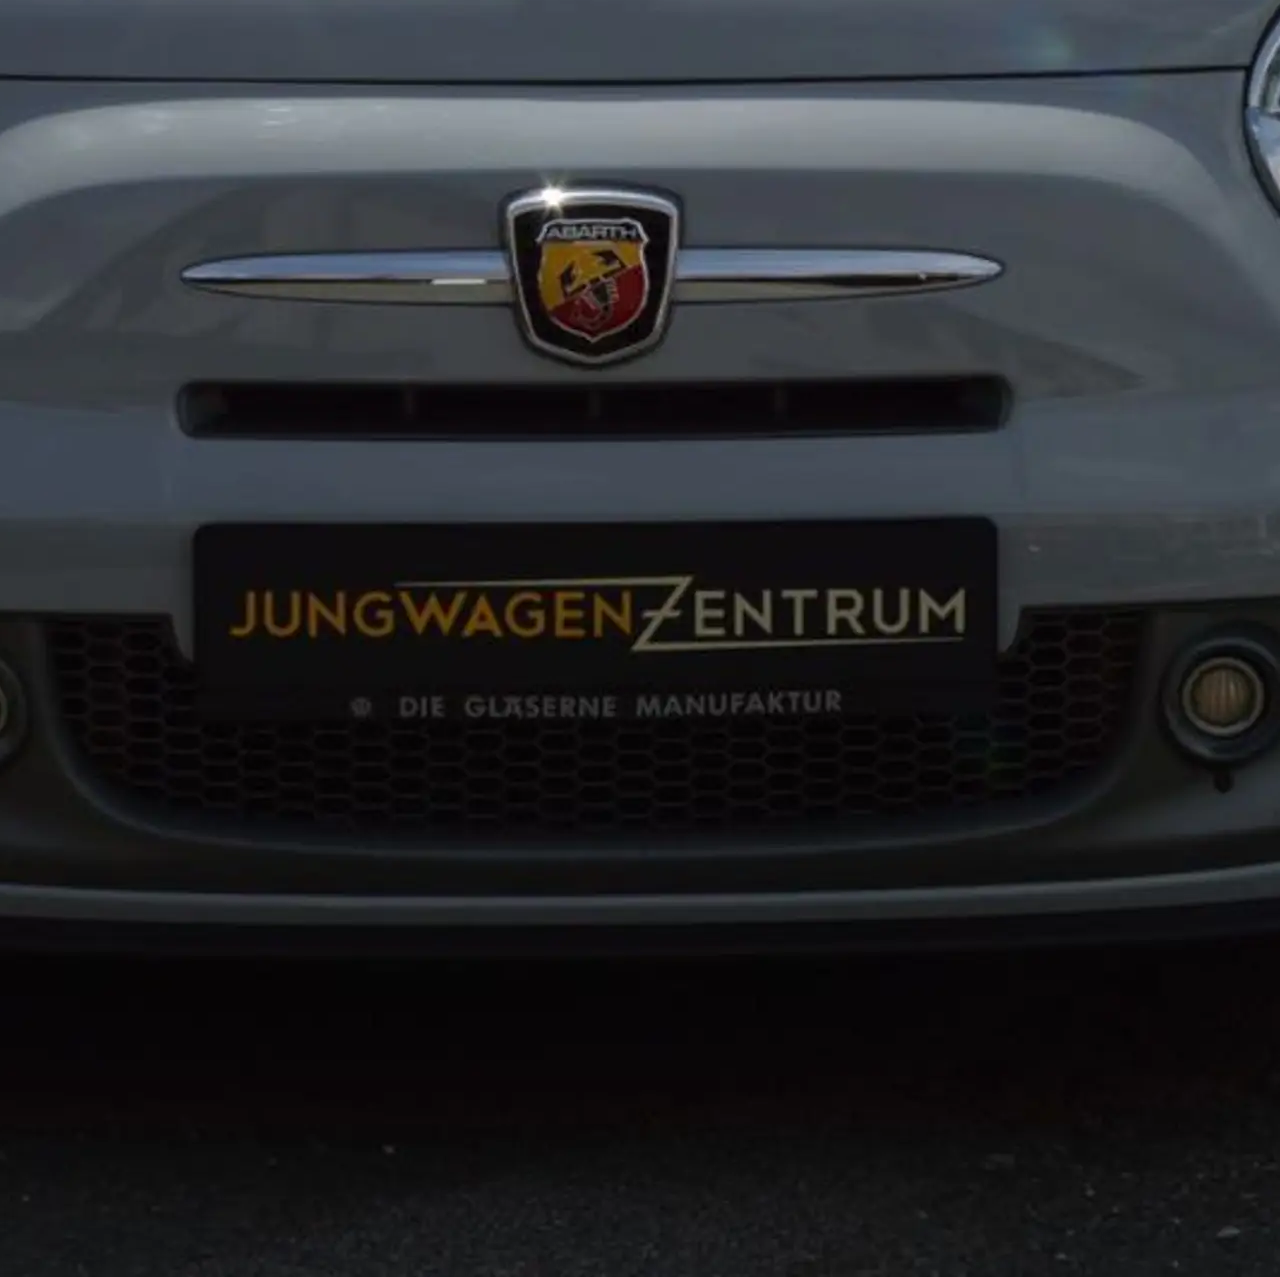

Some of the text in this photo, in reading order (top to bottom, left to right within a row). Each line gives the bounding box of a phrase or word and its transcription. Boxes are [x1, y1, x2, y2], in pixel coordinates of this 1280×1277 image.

[546, 225, 637, 239] ABARTH
[399, 695, 445, 718] DIE
[635, 689, 843, 717] MANUFAKTUR
